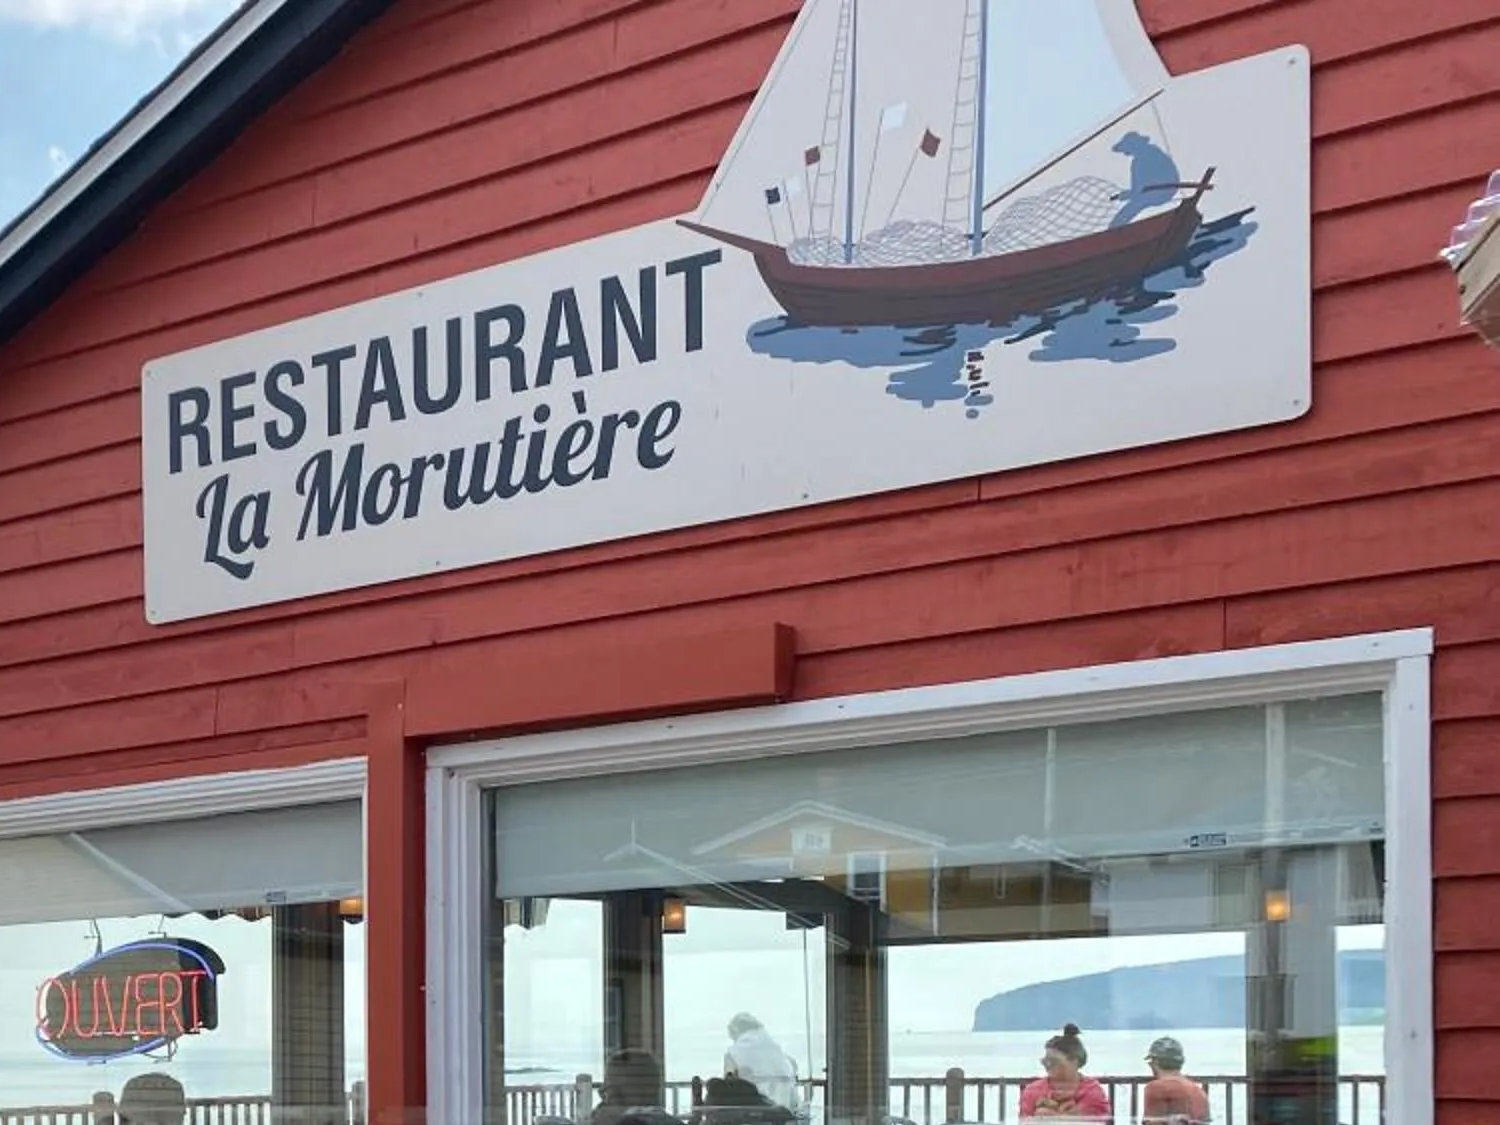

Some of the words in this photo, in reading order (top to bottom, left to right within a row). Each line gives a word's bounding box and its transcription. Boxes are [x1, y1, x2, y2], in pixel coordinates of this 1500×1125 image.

[167, 248, 722, 474] RESTAURANT
[195, 472, 269, 580] La
[295, 391, 682, 541] Morutière
[35, 970, 207, 1039] OUVERT
